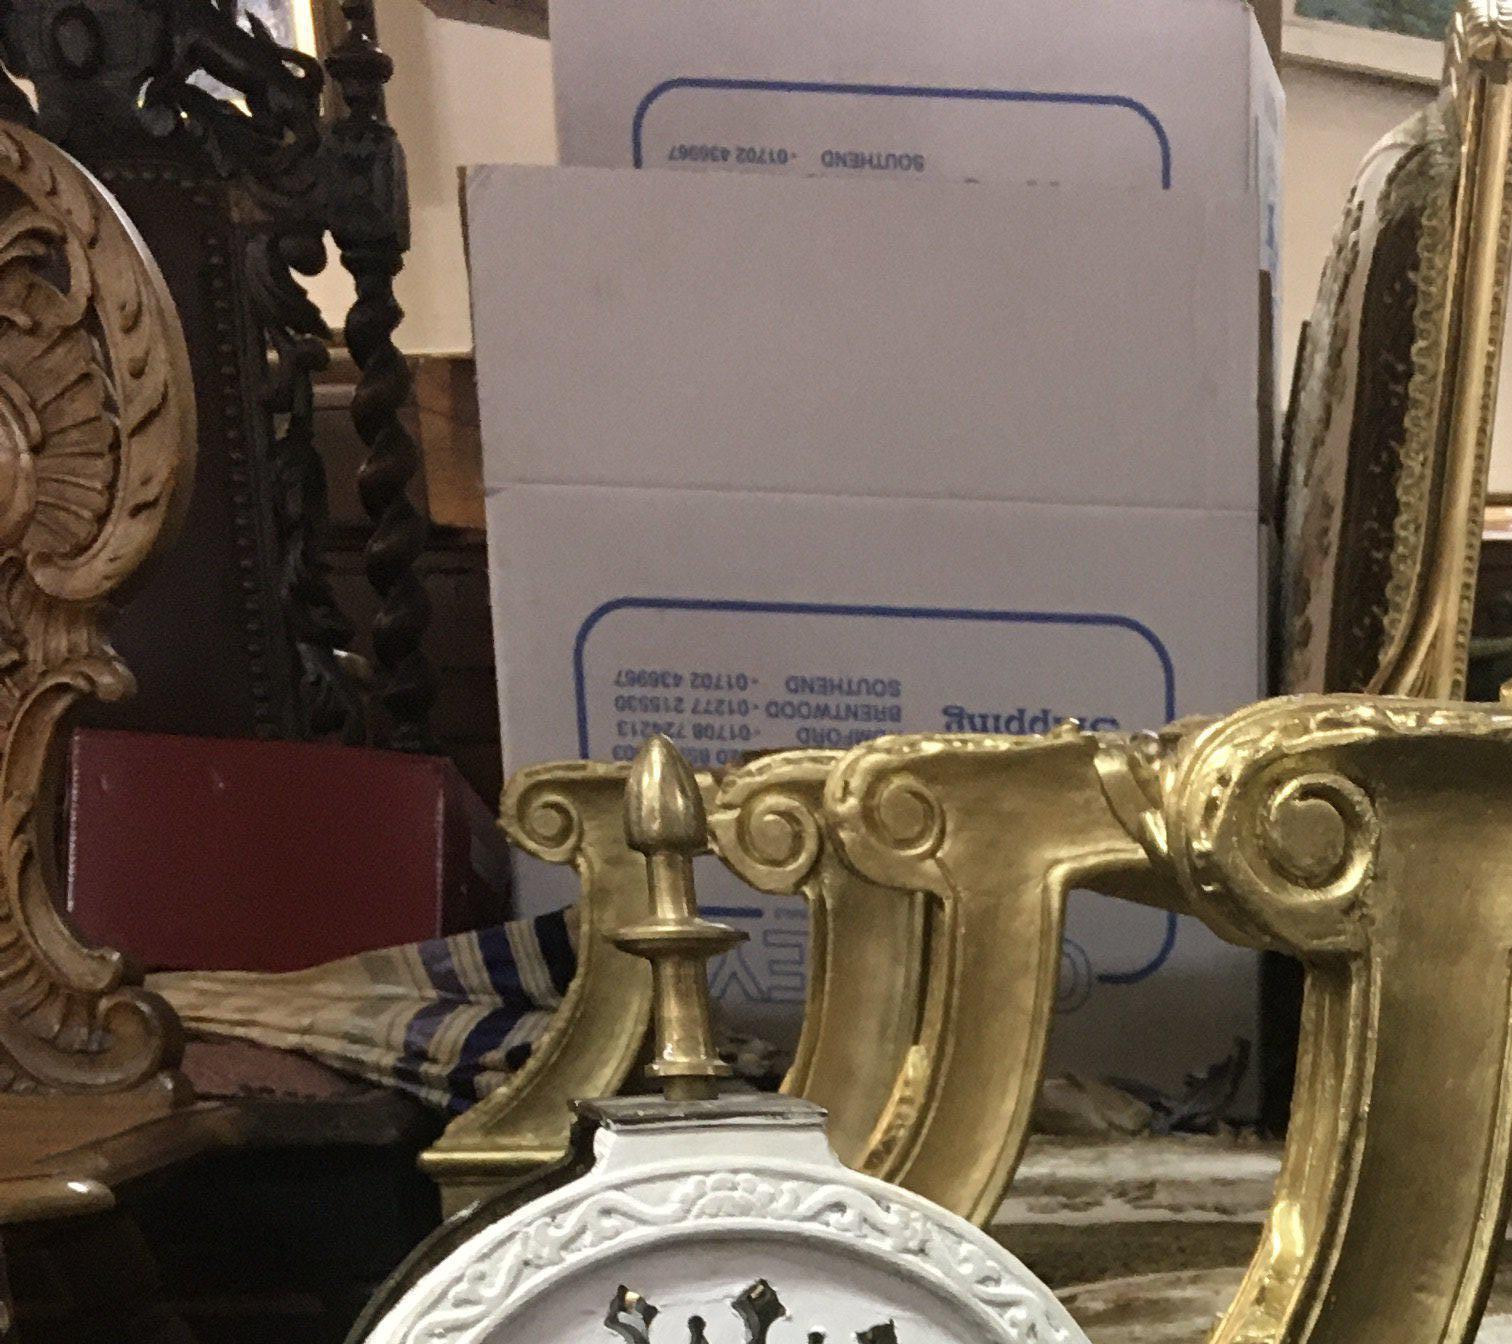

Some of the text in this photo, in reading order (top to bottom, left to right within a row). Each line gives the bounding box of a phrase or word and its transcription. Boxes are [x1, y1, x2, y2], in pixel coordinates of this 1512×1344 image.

[821, 149, 926, 173] SOUTHEND
[785, 675, 902, 698] SOUTHEND
[764, 701, 902, 723] BRENTWOOD
